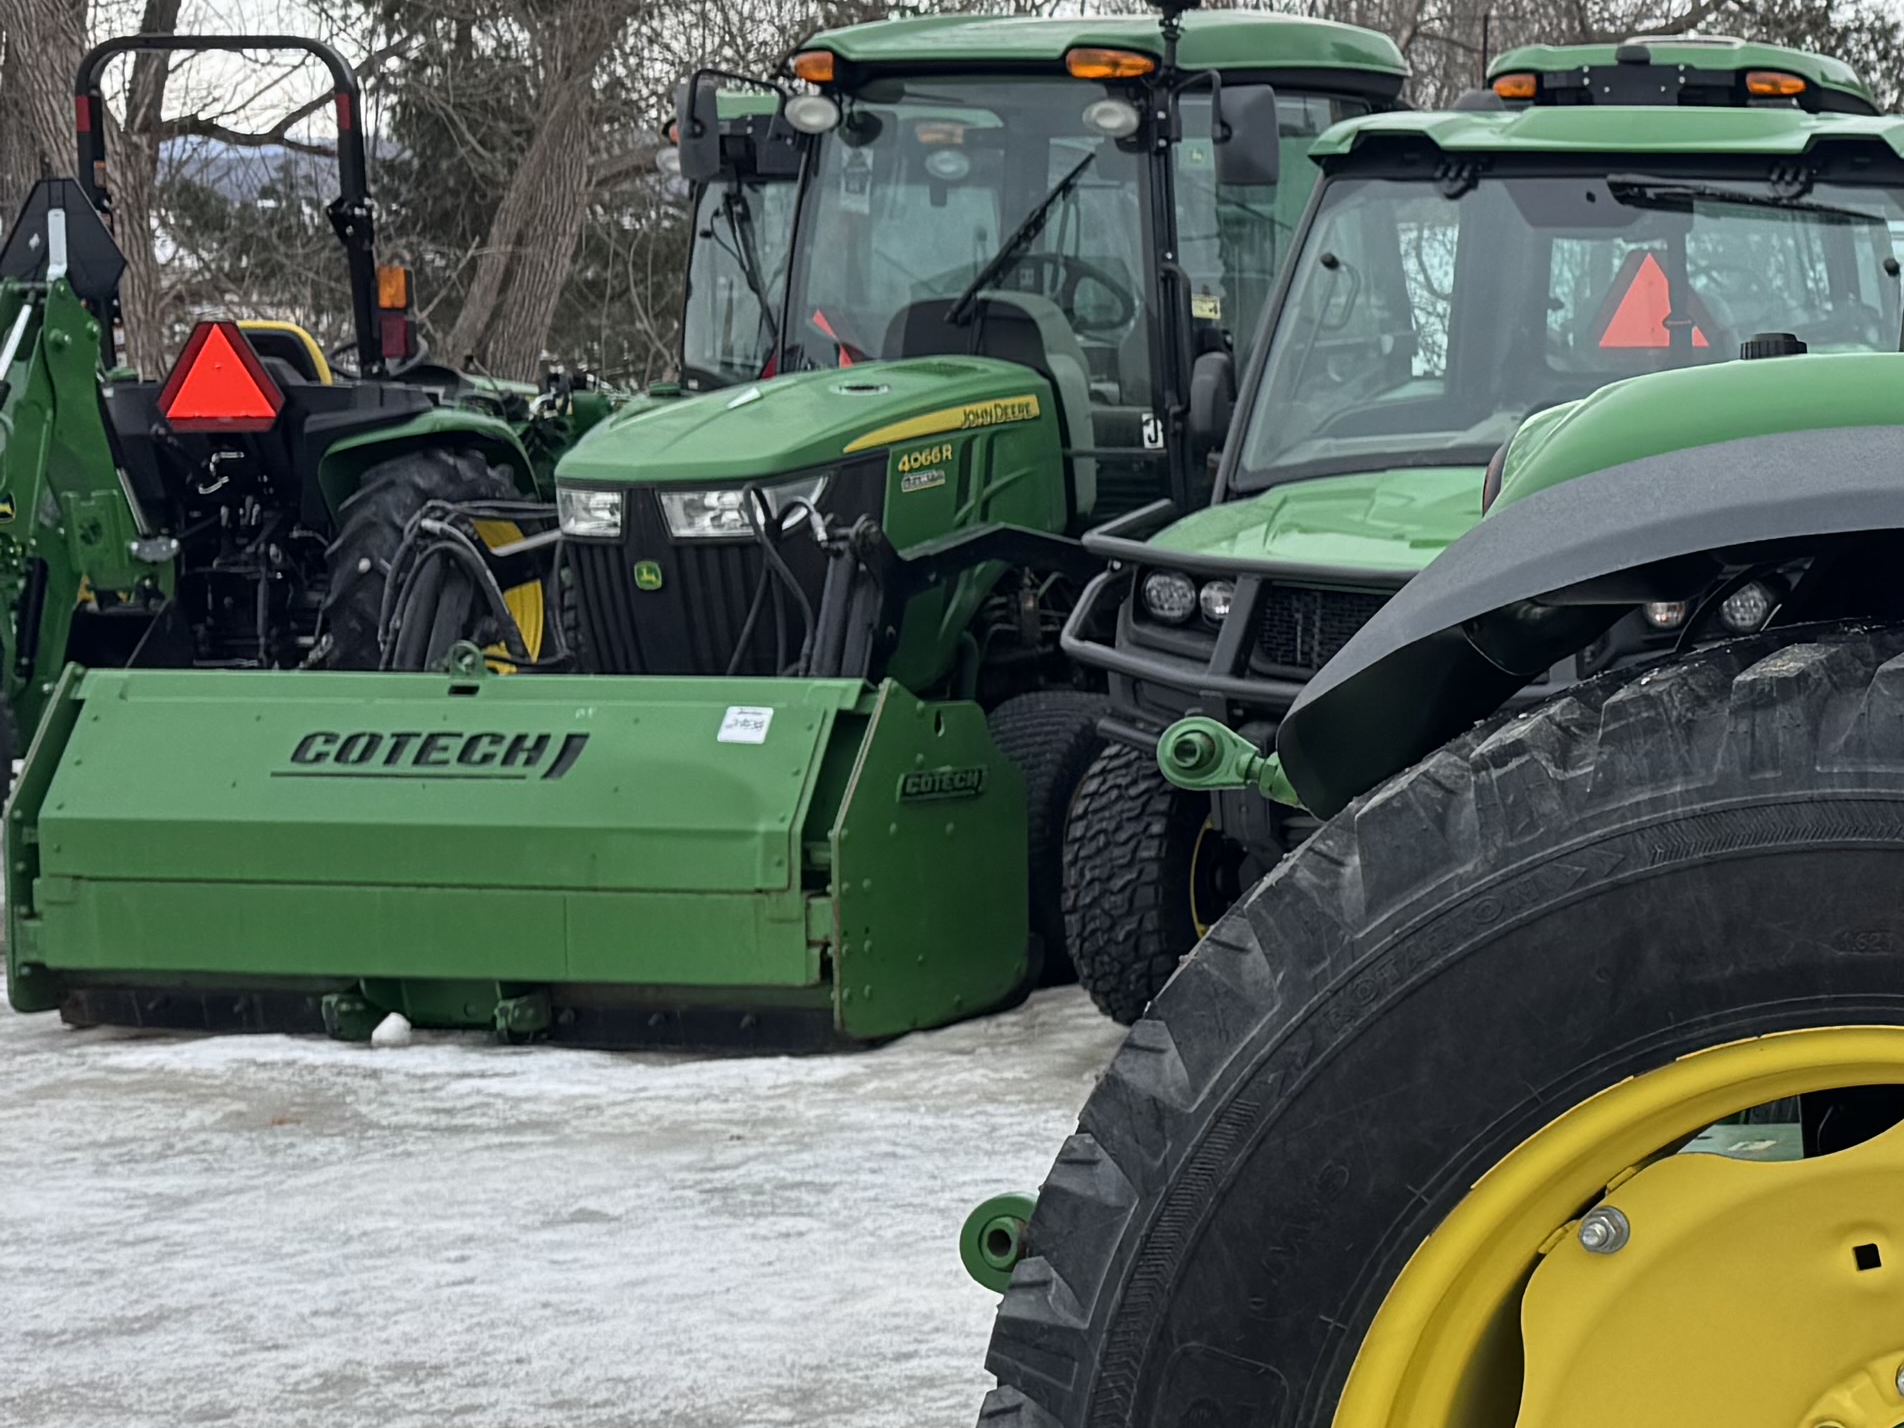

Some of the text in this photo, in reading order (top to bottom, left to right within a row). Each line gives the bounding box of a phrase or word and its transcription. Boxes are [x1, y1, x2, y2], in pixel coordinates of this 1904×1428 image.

[961, 402, 1033, 427] JOHN DEERE
[898, 443, 953, 472] 4066R
[290, 731, 552, 767] COTECH
[905, 770, 981, 794] COTECH
